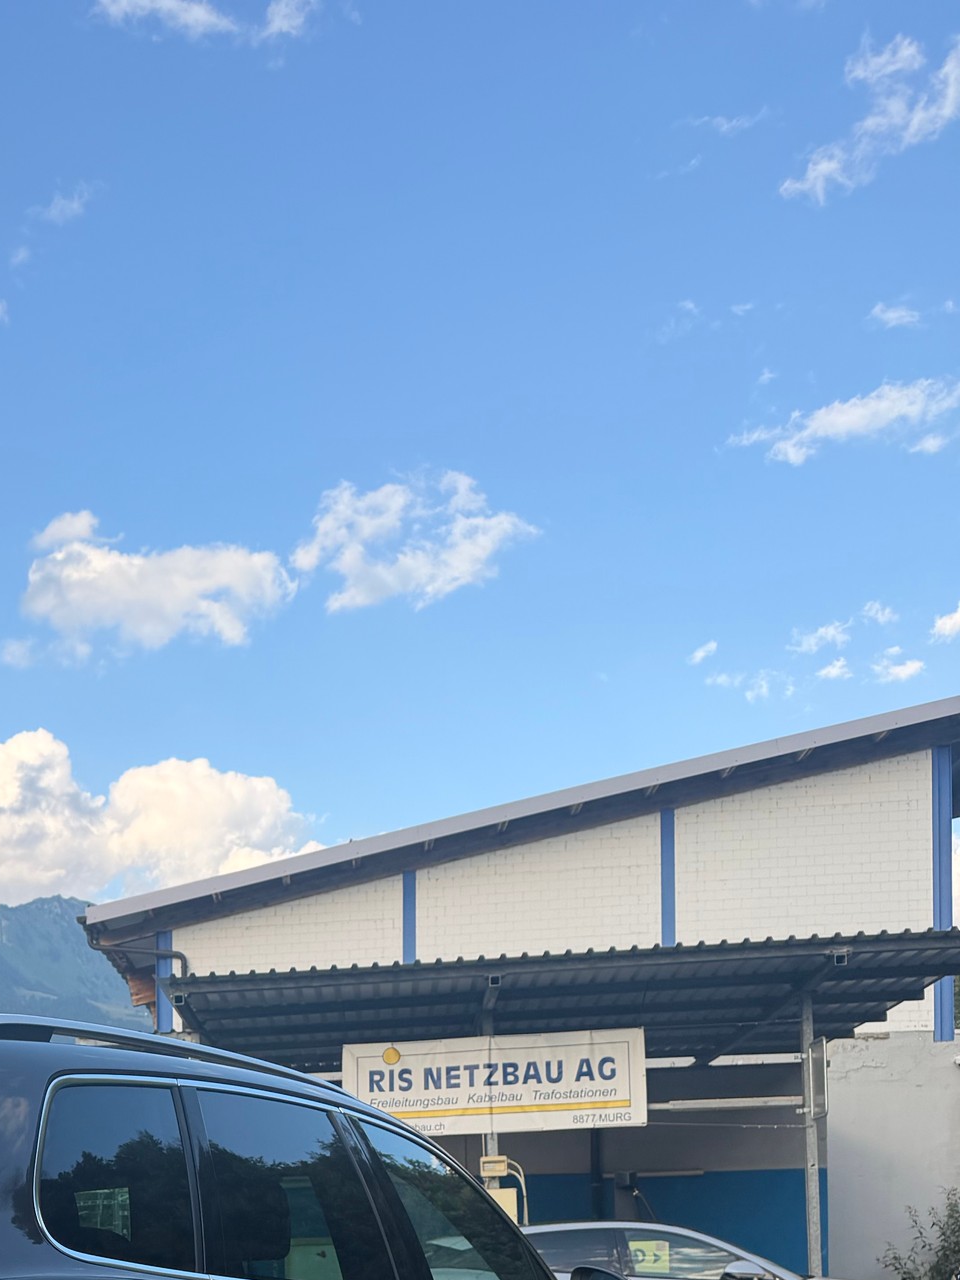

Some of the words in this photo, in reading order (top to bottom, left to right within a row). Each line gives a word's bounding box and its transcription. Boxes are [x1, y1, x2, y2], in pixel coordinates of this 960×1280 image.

[368, 1068, 414, 1093] RIS
[423, 1060, 564, 1091] NETZBAU
[574, 1056, 617, 1082] AG
[369, 1096, 459, 1110] Freileitungsbau
[467, 1091, 523, 1105] Kabelbau
[532, 1087, 618, 1102] Trafostationen
[412, 1121, 446, 1132] bau.ch
[572, 1114, 596, 1125] 8877
[599, 1111, 632, 1123] MURG
